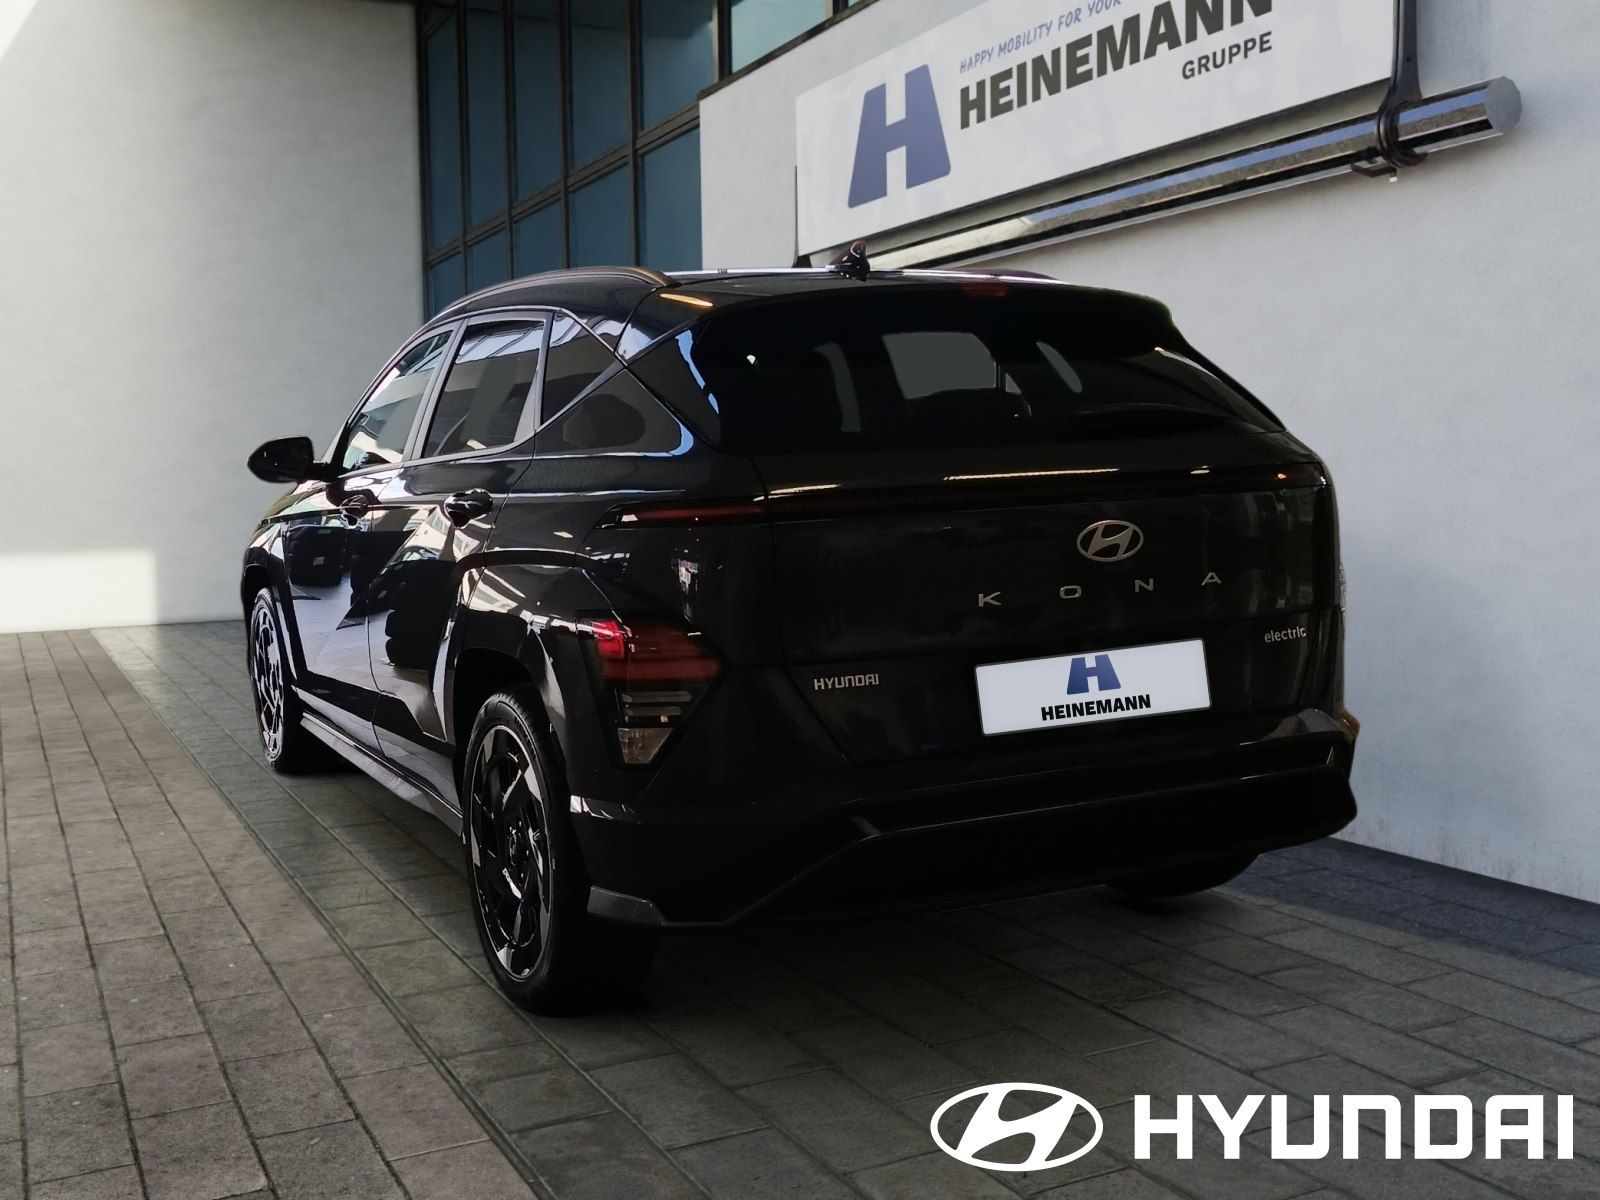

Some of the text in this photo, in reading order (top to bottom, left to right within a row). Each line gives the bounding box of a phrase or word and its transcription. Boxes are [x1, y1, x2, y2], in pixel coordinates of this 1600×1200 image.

[959, 47, 994, 74] HAPPY
[997, 20, 1053, 57] MOBILITY
[1057, 7, 1082, 31] FOR
[1182, 31, 1272, 80] GRUPPE
[1264, 625, 1307, 643] electric
[813, 673, 880, 691] HYUNDAI
[1040, 693, 1152, 722] HEINEMANN
